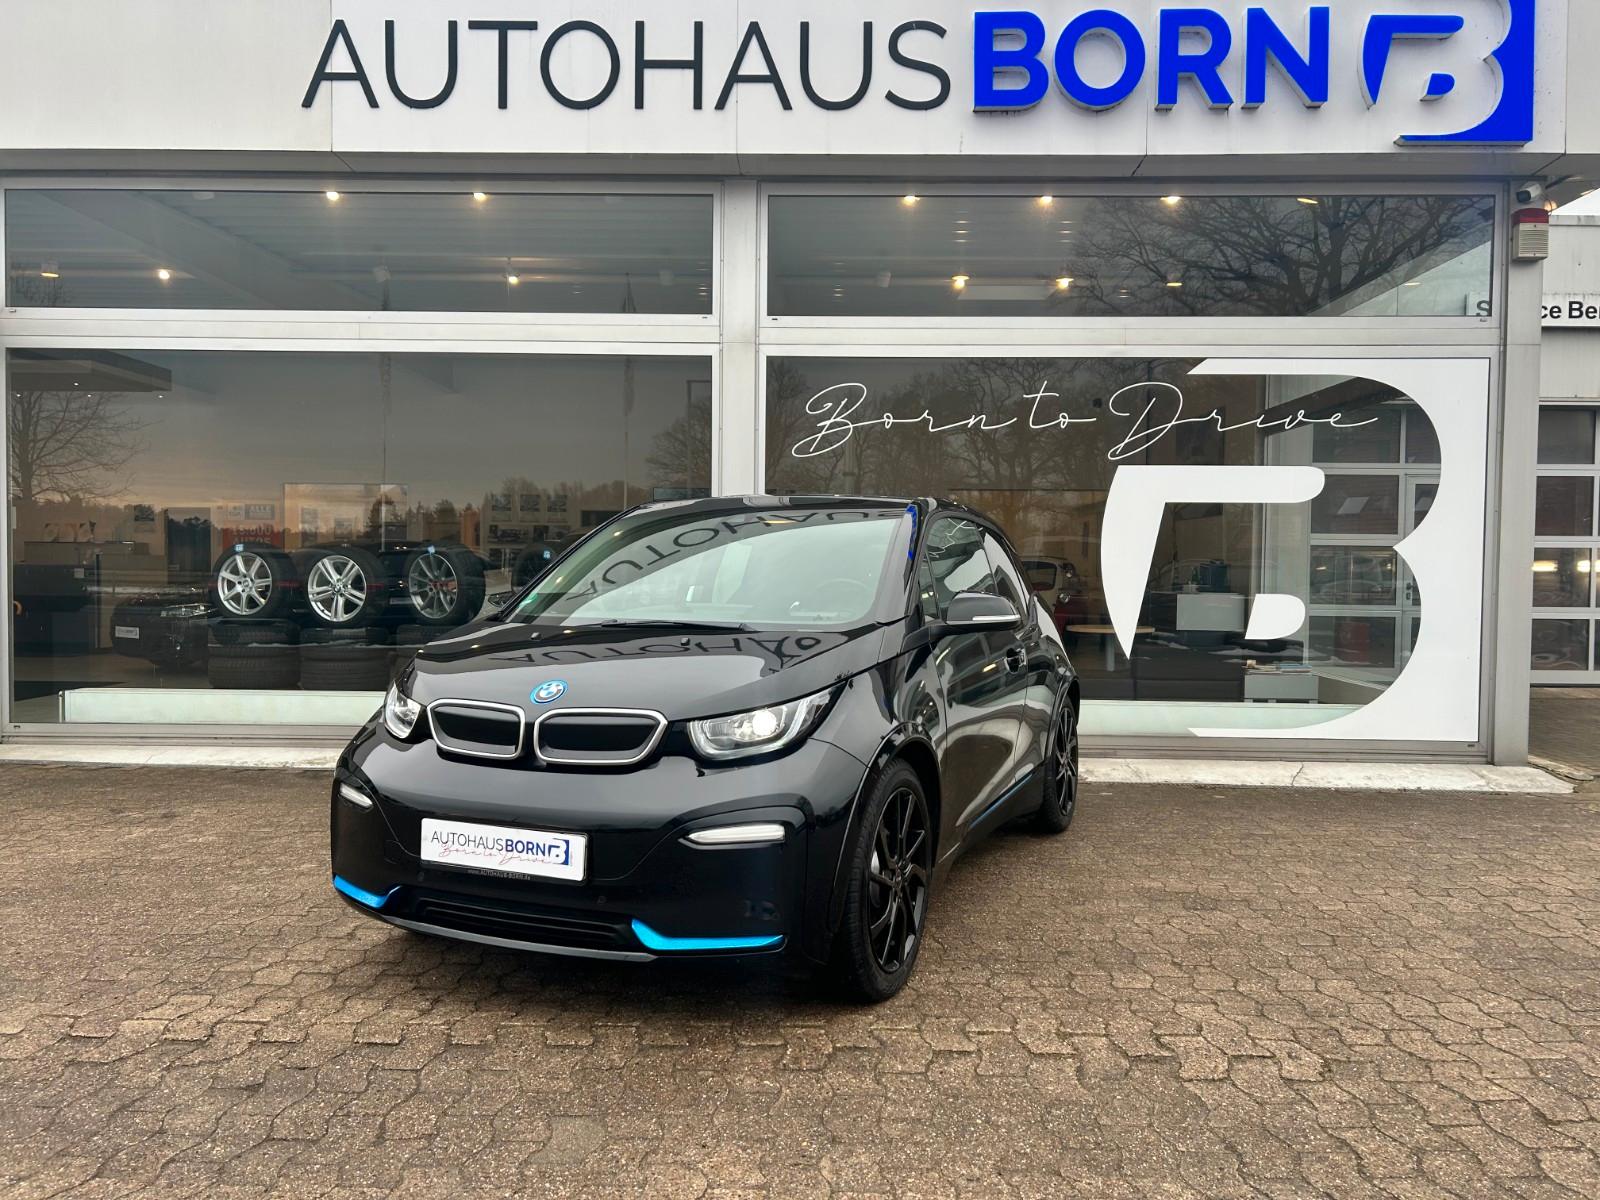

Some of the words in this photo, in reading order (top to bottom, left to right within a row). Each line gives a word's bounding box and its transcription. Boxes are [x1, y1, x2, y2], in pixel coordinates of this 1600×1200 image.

[1568, 300, 1600, 319] Be
[791, 382, 1017, 458] Born
[1003, 380, 1097, 429] to
[1107, 381, 1379, 461] Drive
